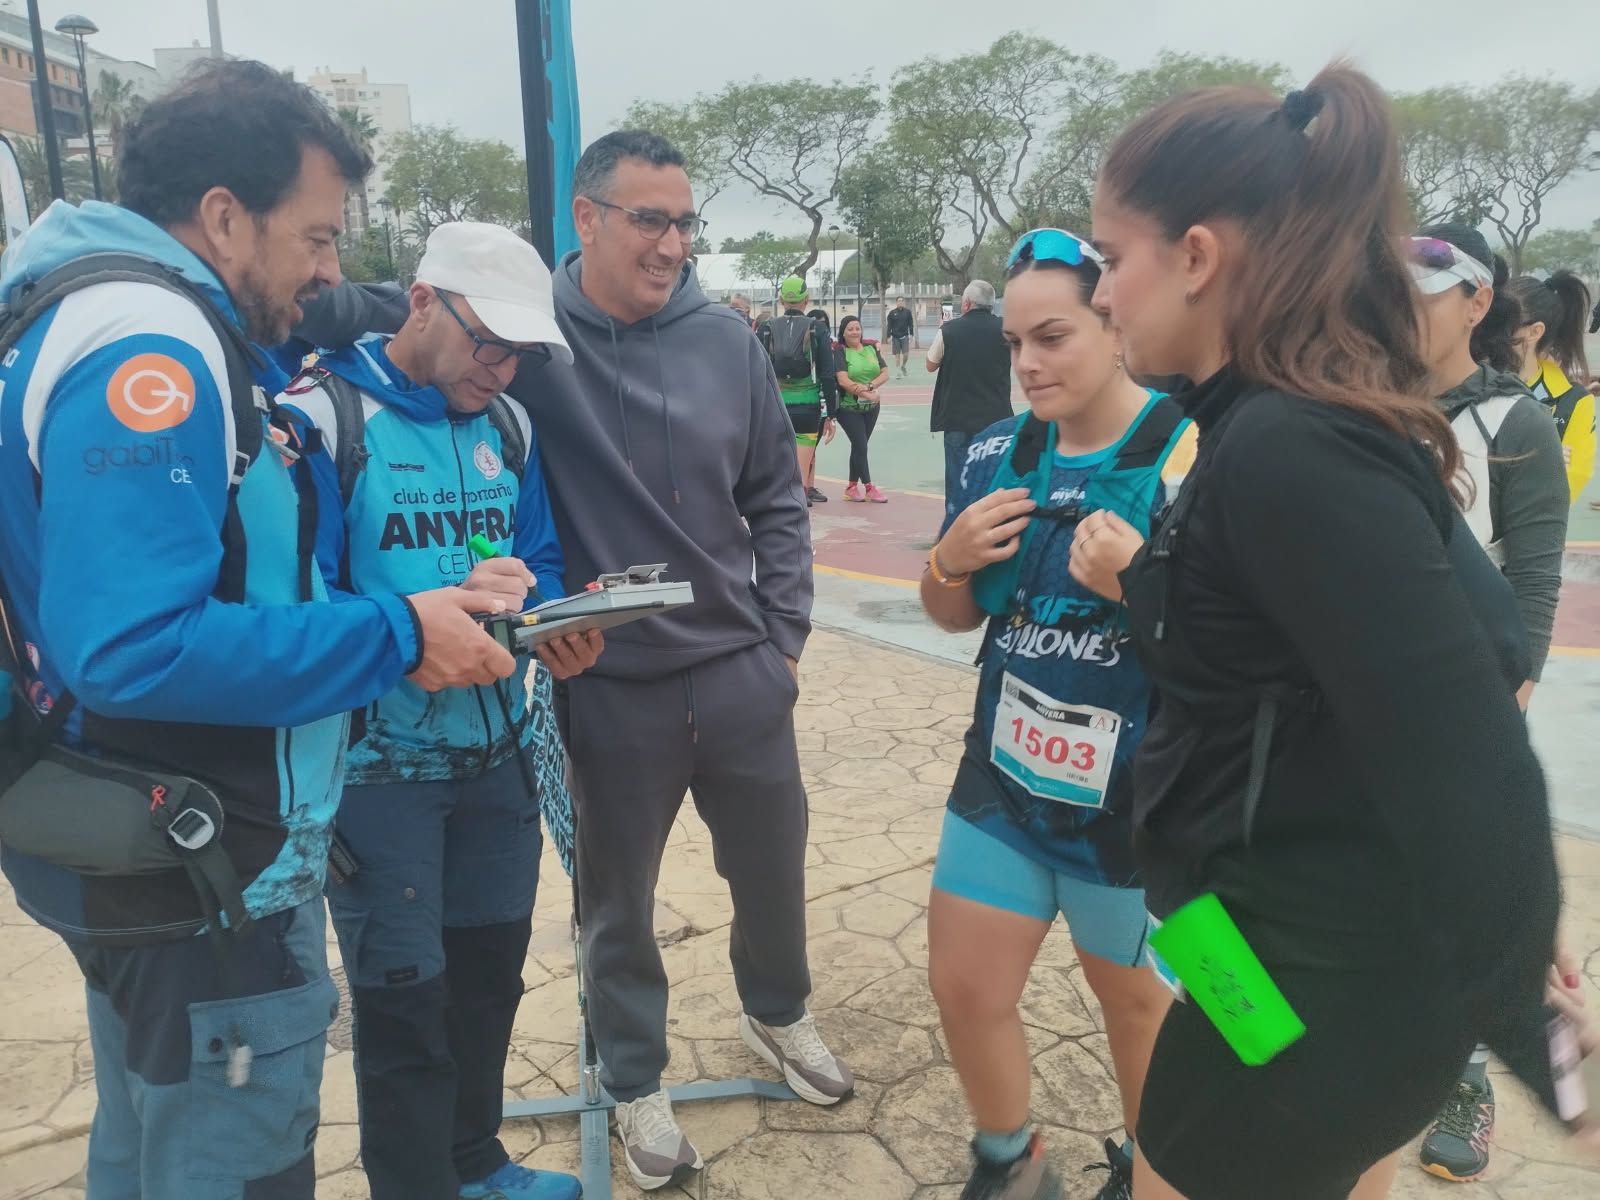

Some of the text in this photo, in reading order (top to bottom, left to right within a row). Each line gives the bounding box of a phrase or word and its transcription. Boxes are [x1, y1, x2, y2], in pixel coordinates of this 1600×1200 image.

[394, 488, 429, 504] club
[433, 488, 456, 504] de
[437, 552, 479, 575] CEU
[1011, 716, 1096, 771] 1503
